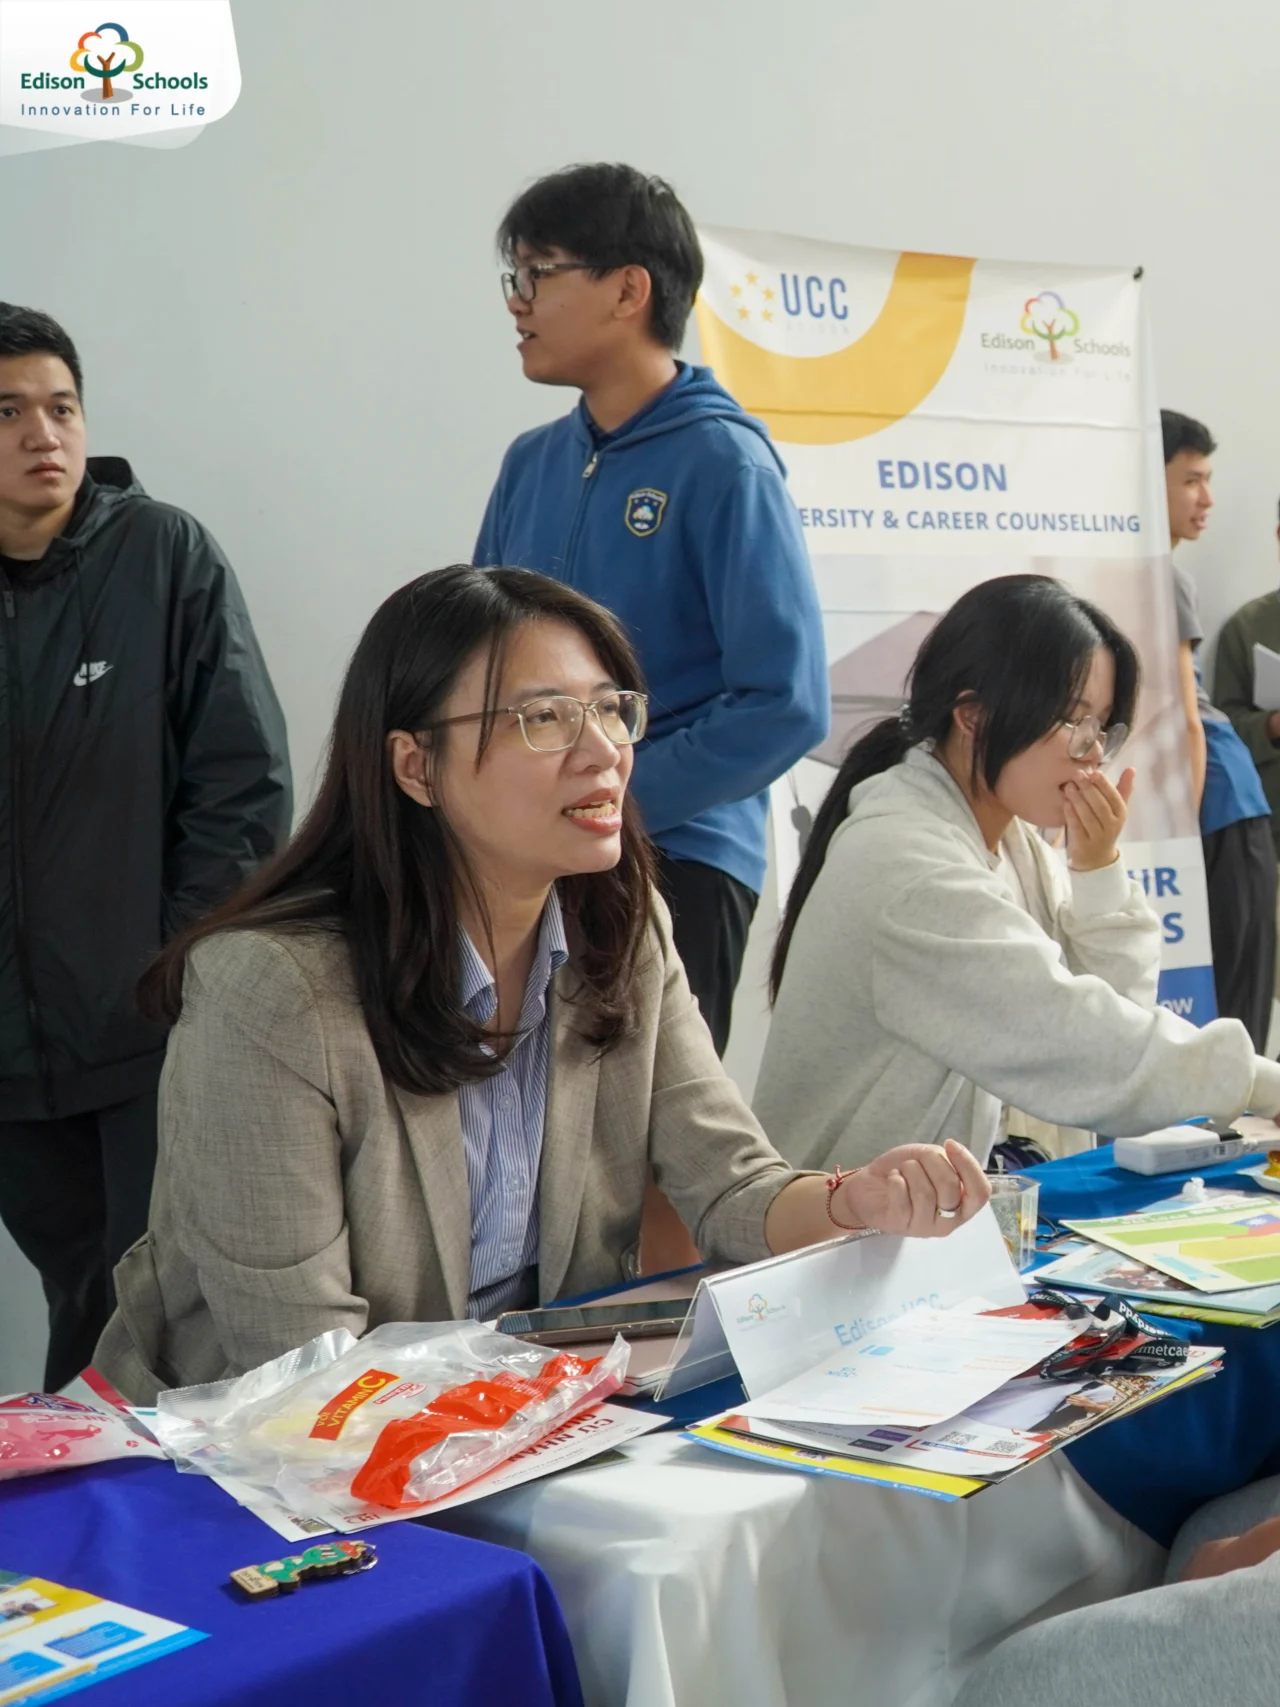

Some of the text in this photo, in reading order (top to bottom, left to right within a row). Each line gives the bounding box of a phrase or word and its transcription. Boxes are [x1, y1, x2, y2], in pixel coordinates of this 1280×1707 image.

[780, 272, 848, 320] UCC
[980, 332, 1131, 358] Edison Schools
[877, 459, 1008, 491] EDISON
[799, 508, 1141, 533] ERSITY & CAREER COUNSELLING
[1127, 866, 1181, 898] UR
[1162, 912, 1185, 944] S
[326, 1375, 386, 1428] VITAMIN C
